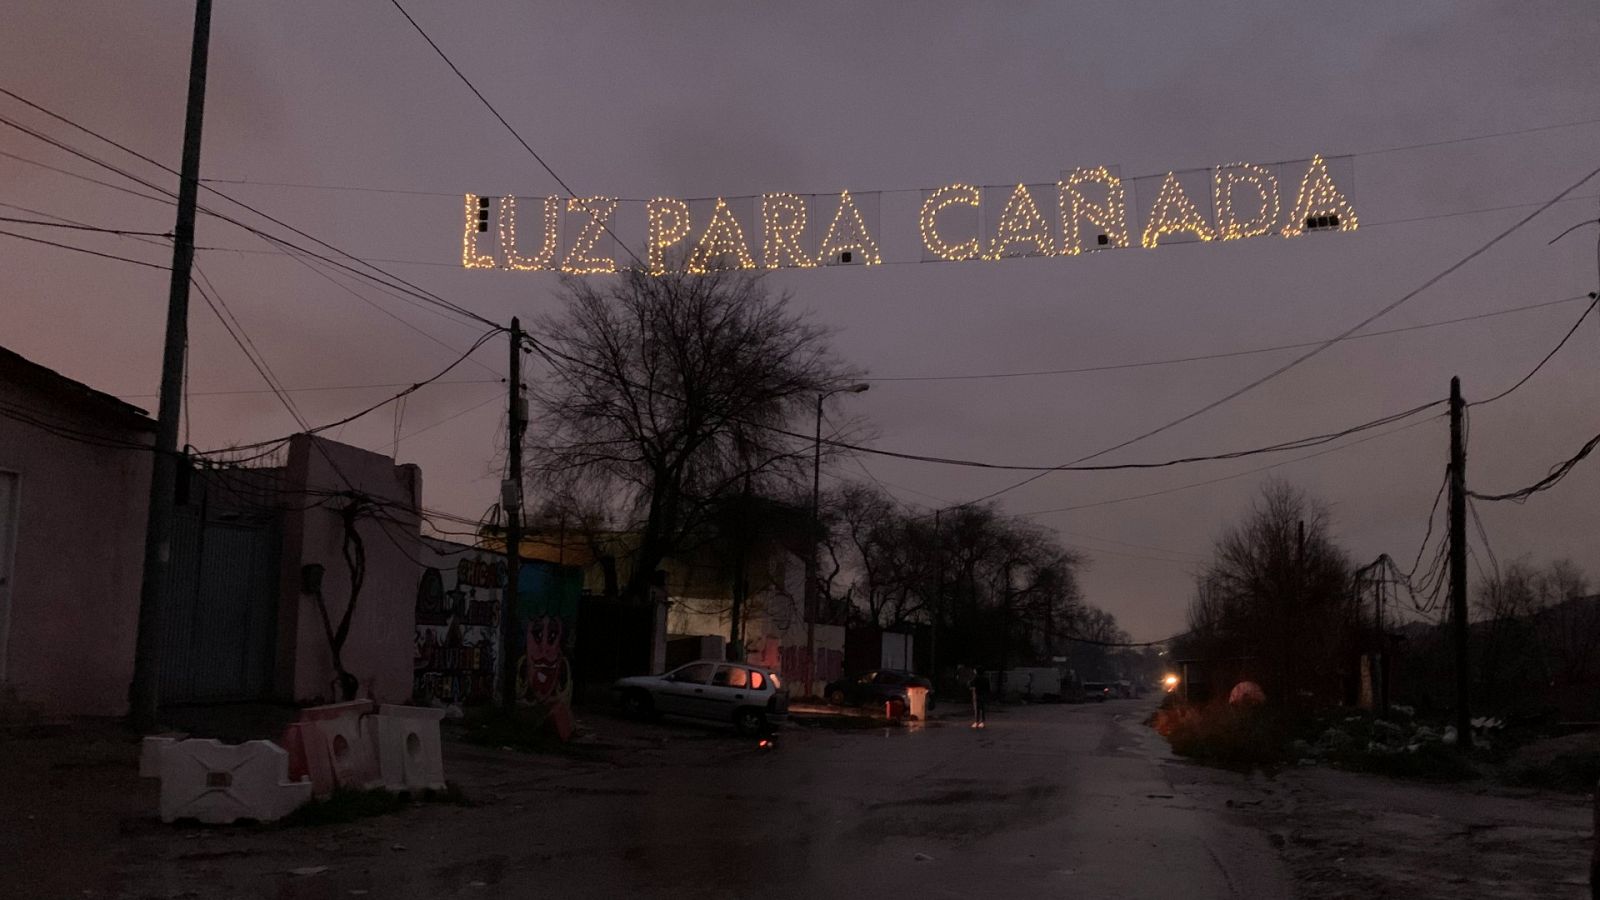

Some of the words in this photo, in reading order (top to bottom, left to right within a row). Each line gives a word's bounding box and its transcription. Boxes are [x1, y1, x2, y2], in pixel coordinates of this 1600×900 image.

[463, 193, 617, 274] LUZ
[646, 190, 881, 276] PARA
[919, 154, 1359, 261] CAÑADA
